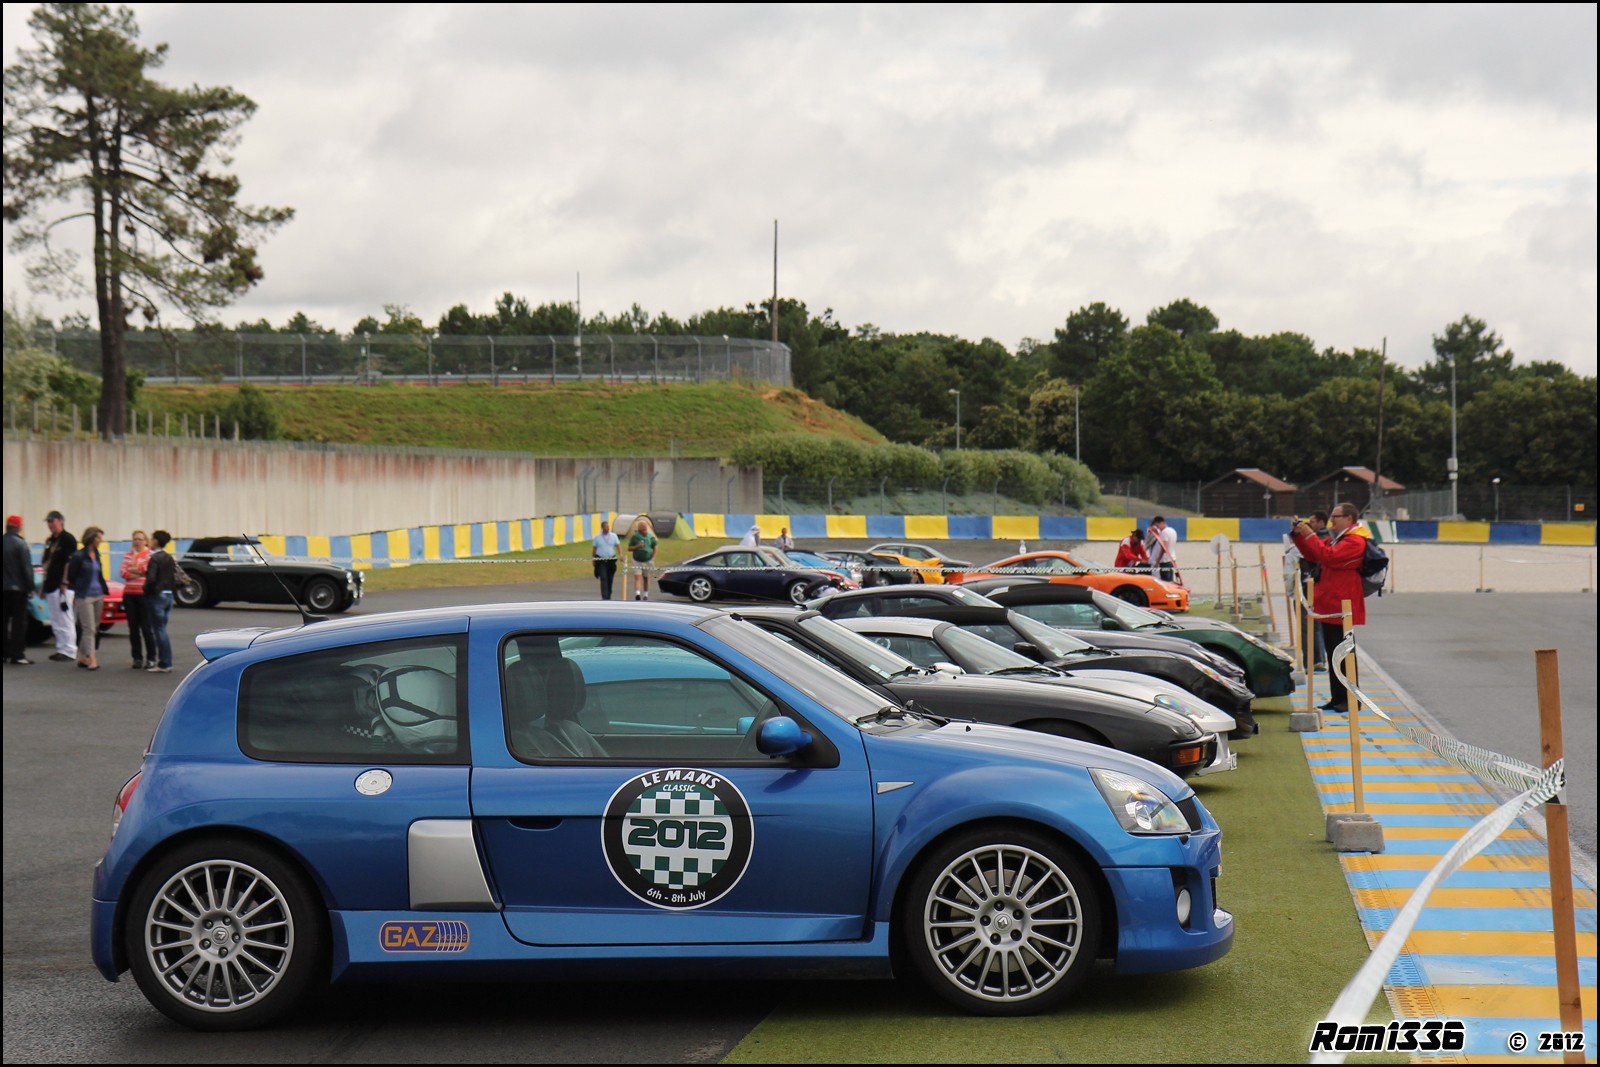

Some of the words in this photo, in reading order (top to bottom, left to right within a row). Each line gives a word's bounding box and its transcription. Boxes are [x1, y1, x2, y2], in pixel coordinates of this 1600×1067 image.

[640, 772, 661, 788] LE
[664, 770, 720, 789] MANS
[662, 784, 696, 792] CLASSIC
[628, 818, 727, 851] 2012
[646, 888, 662, 900] 6th
[671, 893, 686, 903] 8th
[688, 890, 706, 902] July
[384, 926, 437, 947] GAZ
